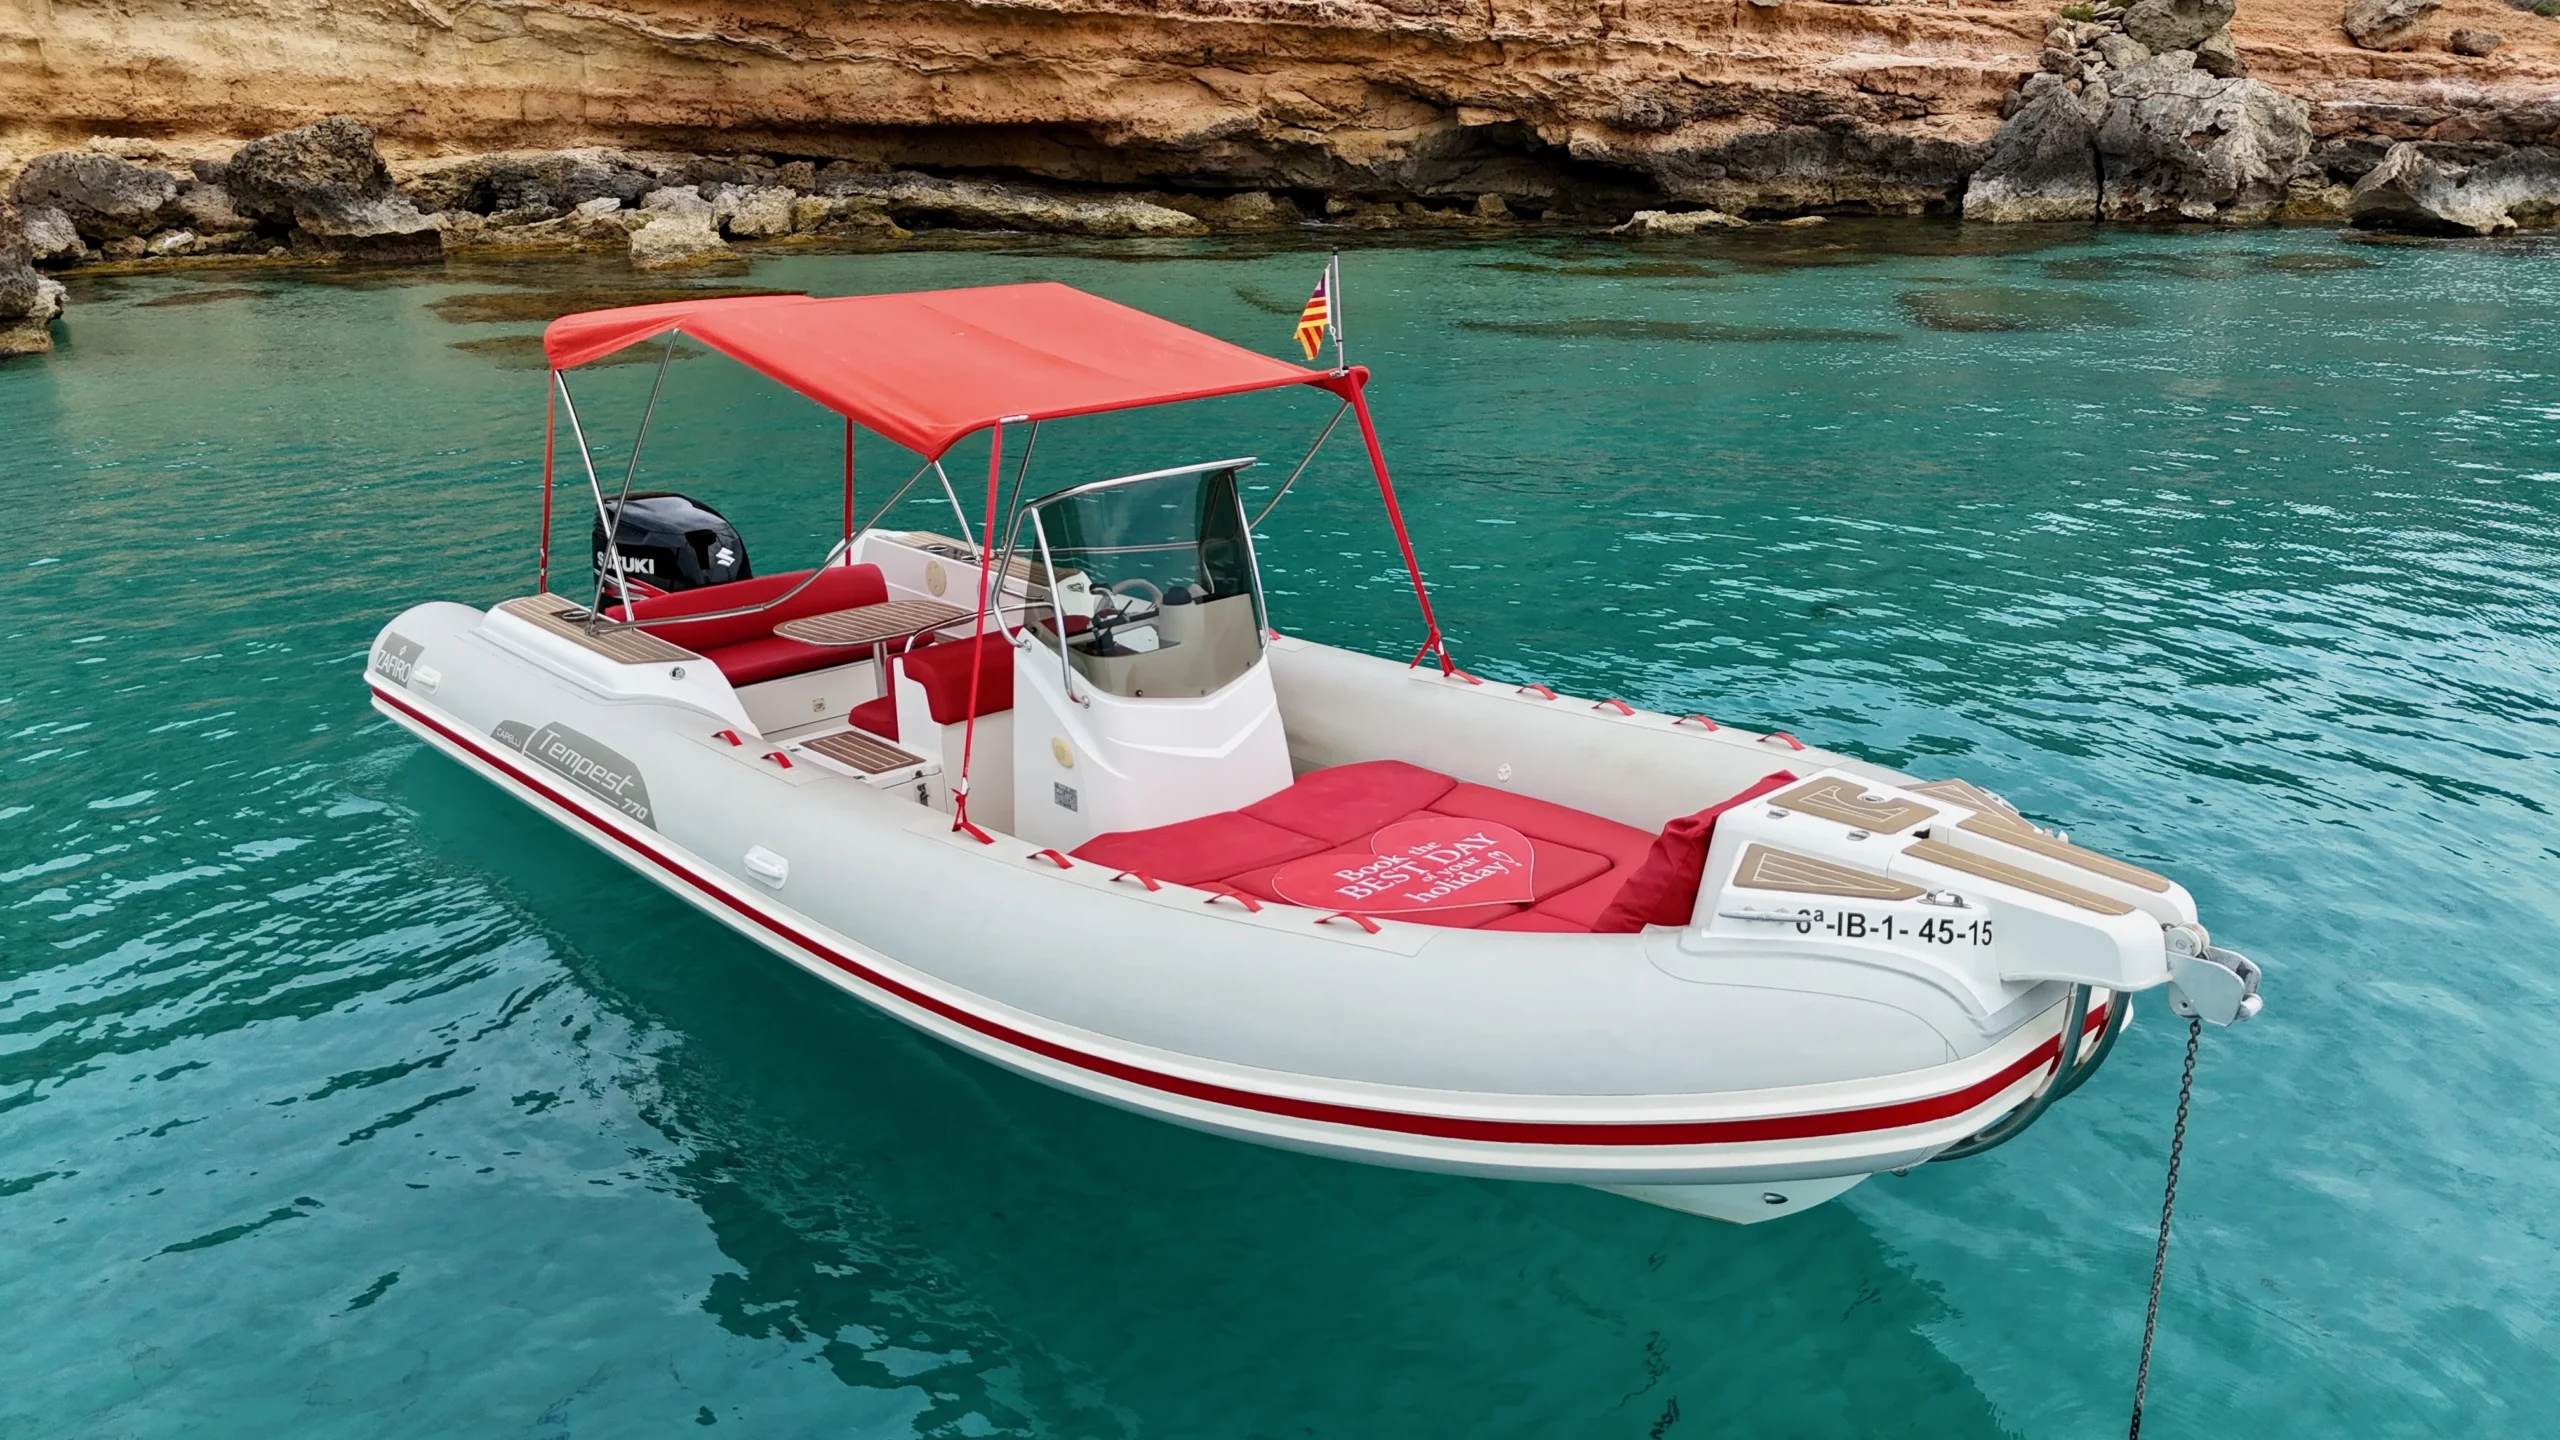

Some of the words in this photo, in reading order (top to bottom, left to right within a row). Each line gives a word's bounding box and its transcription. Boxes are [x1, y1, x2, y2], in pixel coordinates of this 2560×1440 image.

[376, 649, 411, 683] ZAFIRO
[496, 727, 522, 748] CAPELLI
[538, 729, 634, 796] Tempest
[623, 797, 649, 820] 770
[1333, 854, 1411, 882] Book
[1408, 840, 1442, 856] the
[1335, 861, 1430, 900] BEST
[1422, 832, 1499, 865] DAY
[1422, 873, 1439, 882] of
[1437, 856, 1482, 878] your
